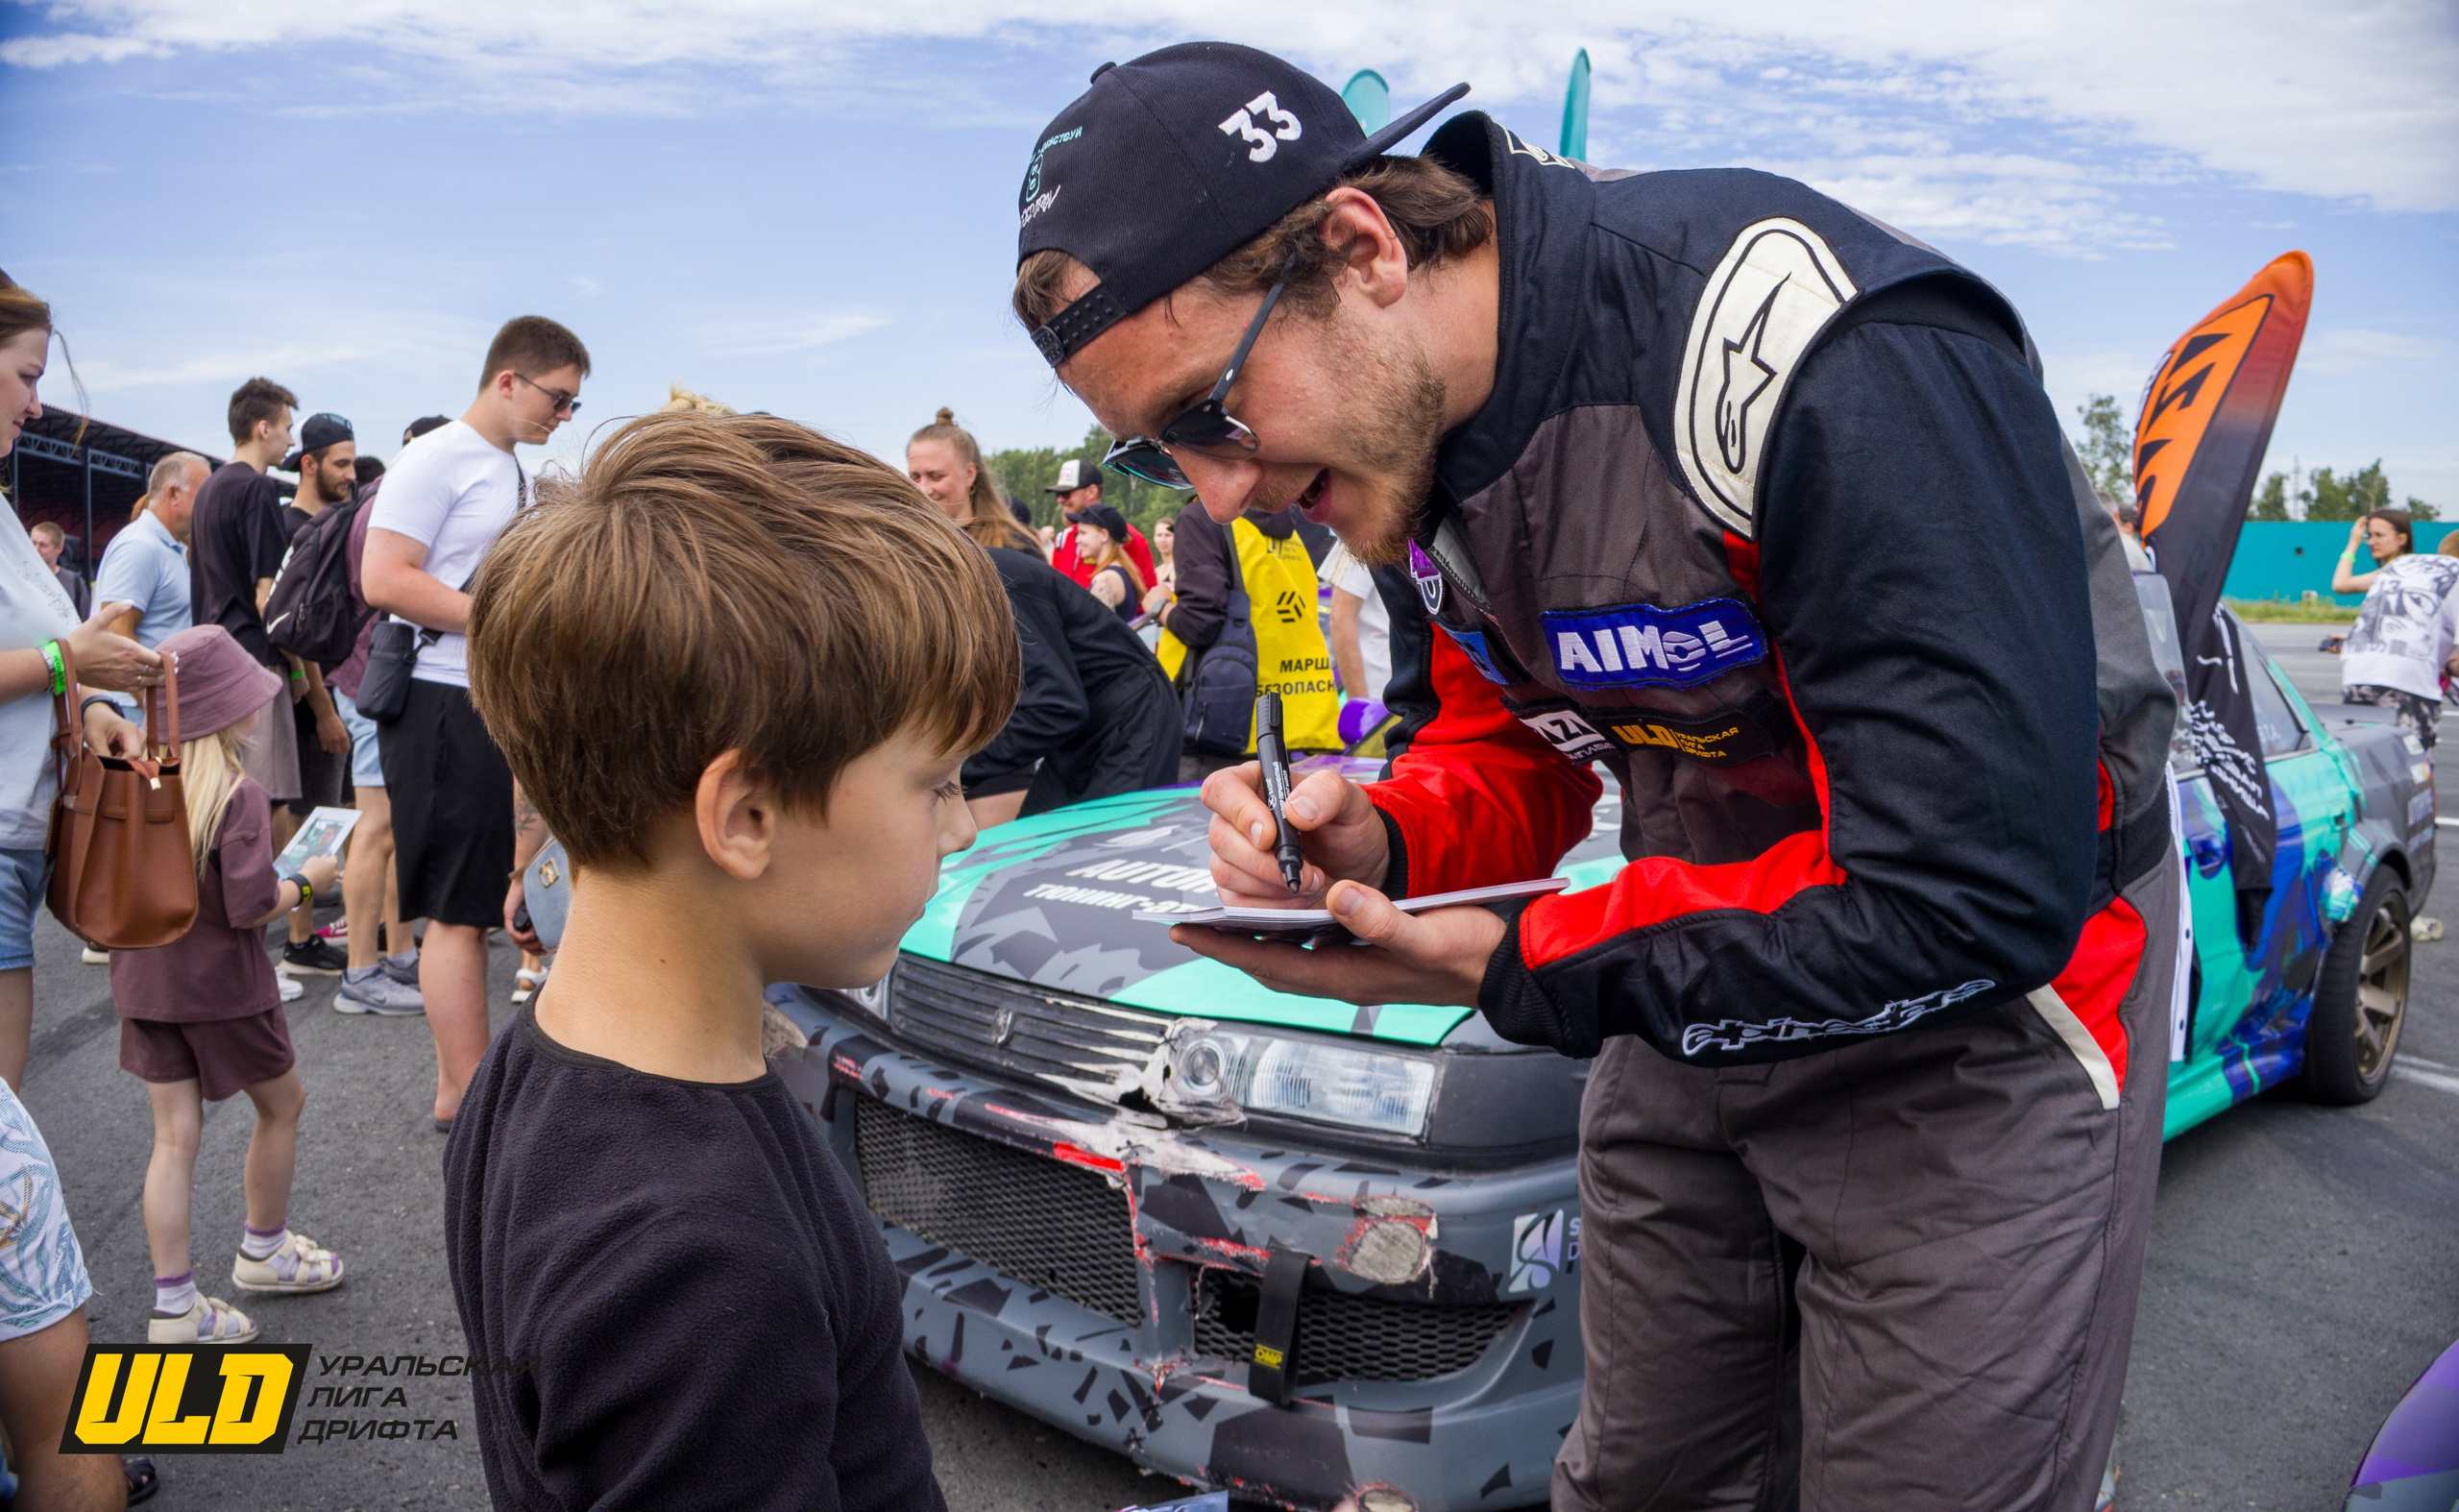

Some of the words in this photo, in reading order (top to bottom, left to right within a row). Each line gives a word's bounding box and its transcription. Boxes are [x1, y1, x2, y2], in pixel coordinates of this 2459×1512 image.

[1218, 90, 1303, 162] 33
[1557, 620, 1754, 672] AIMOL
[1612, 724, 1679, 748] ULD
[1675, 727, 1740, 744] УРАЛЬСКАЯ
